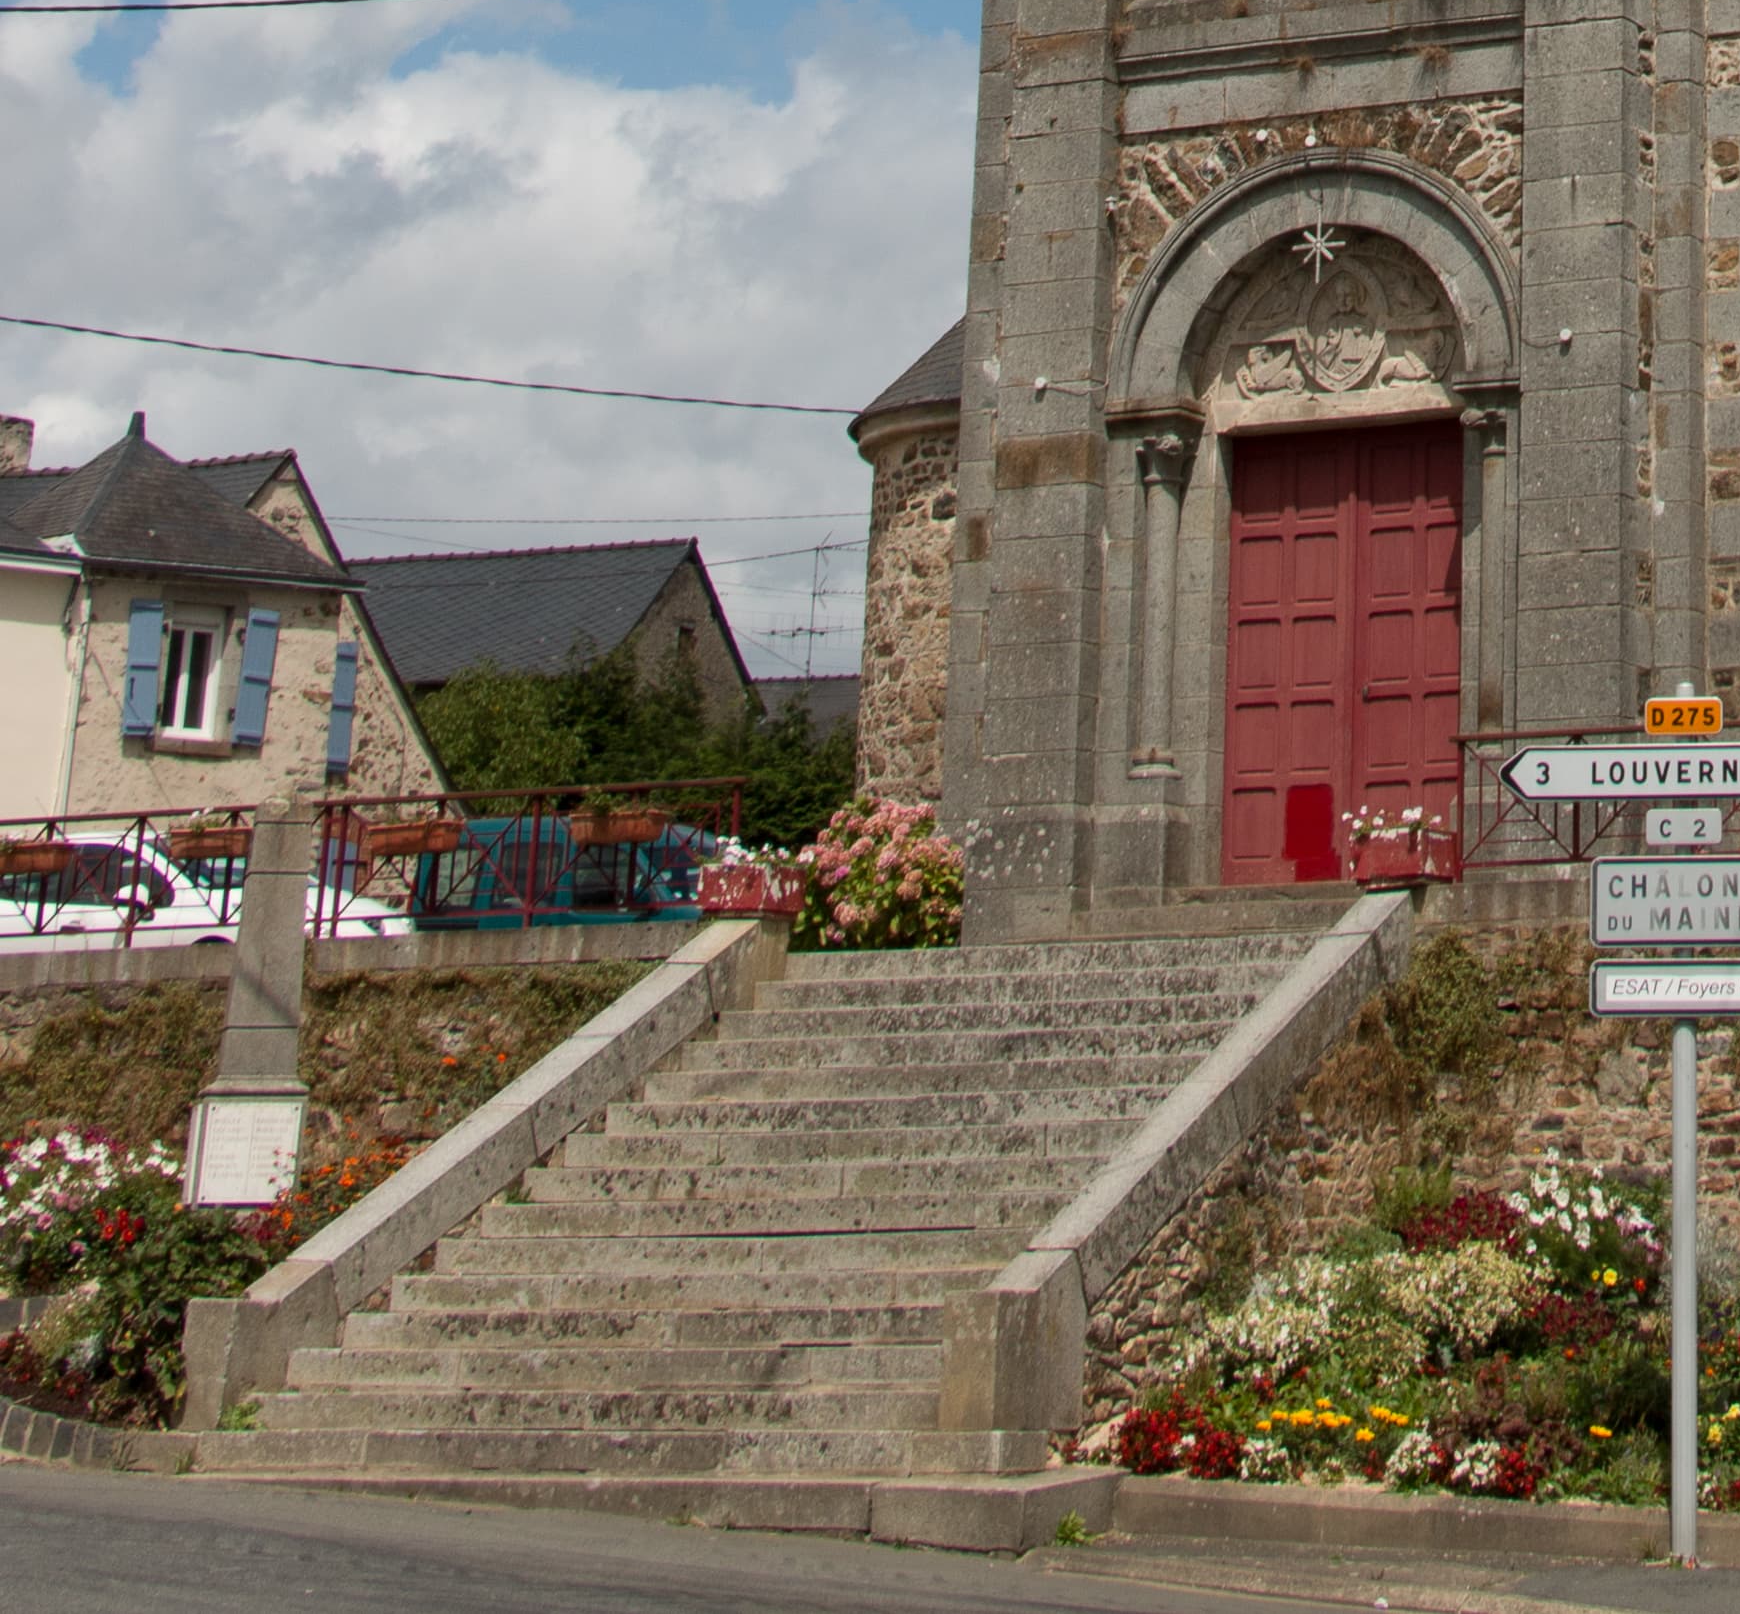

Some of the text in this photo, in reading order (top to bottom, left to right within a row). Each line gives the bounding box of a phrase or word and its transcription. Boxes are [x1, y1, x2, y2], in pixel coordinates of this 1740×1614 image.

[1652, 708, 1715, 726] D 275
[1535, 761, 1550, 785] 3
[1659, 819, 1706, 837] C 2
[1607, 915, 1633, 931] DU
[1612, 978, 1662, 995] ESAT
[1677, 978, 1736, 999] Foyers
